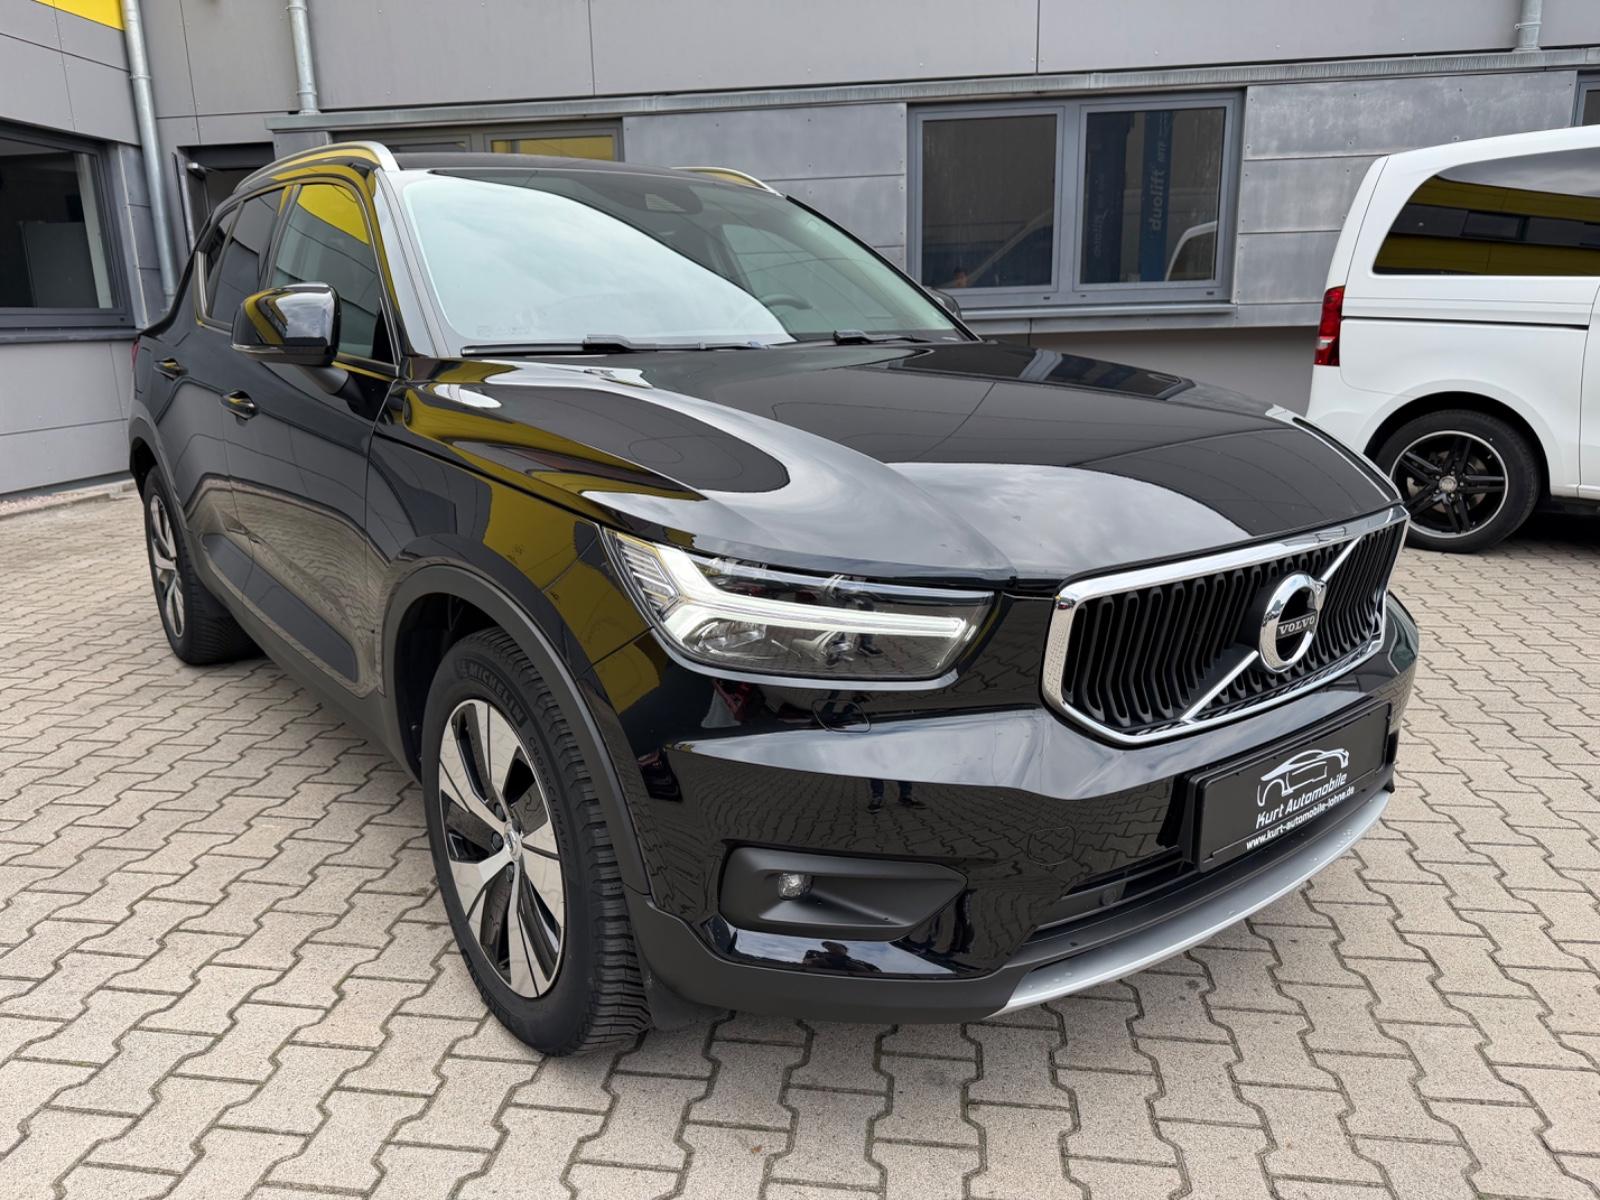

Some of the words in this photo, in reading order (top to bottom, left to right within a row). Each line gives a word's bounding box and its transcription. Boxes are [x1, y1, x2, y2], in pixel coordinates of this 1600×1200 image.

[1149, 168, 1166, 231] duolift
[1279, 616, 1315, 634] VOLVO
[469, 662, 526, 722] MICHELIN
[1246, 786, 1355, 850] www.kurt-automobile-lohne.de
[1255, 805, 1285, 829] Kurt
[1285, 773, 1348, 815] Automobile
